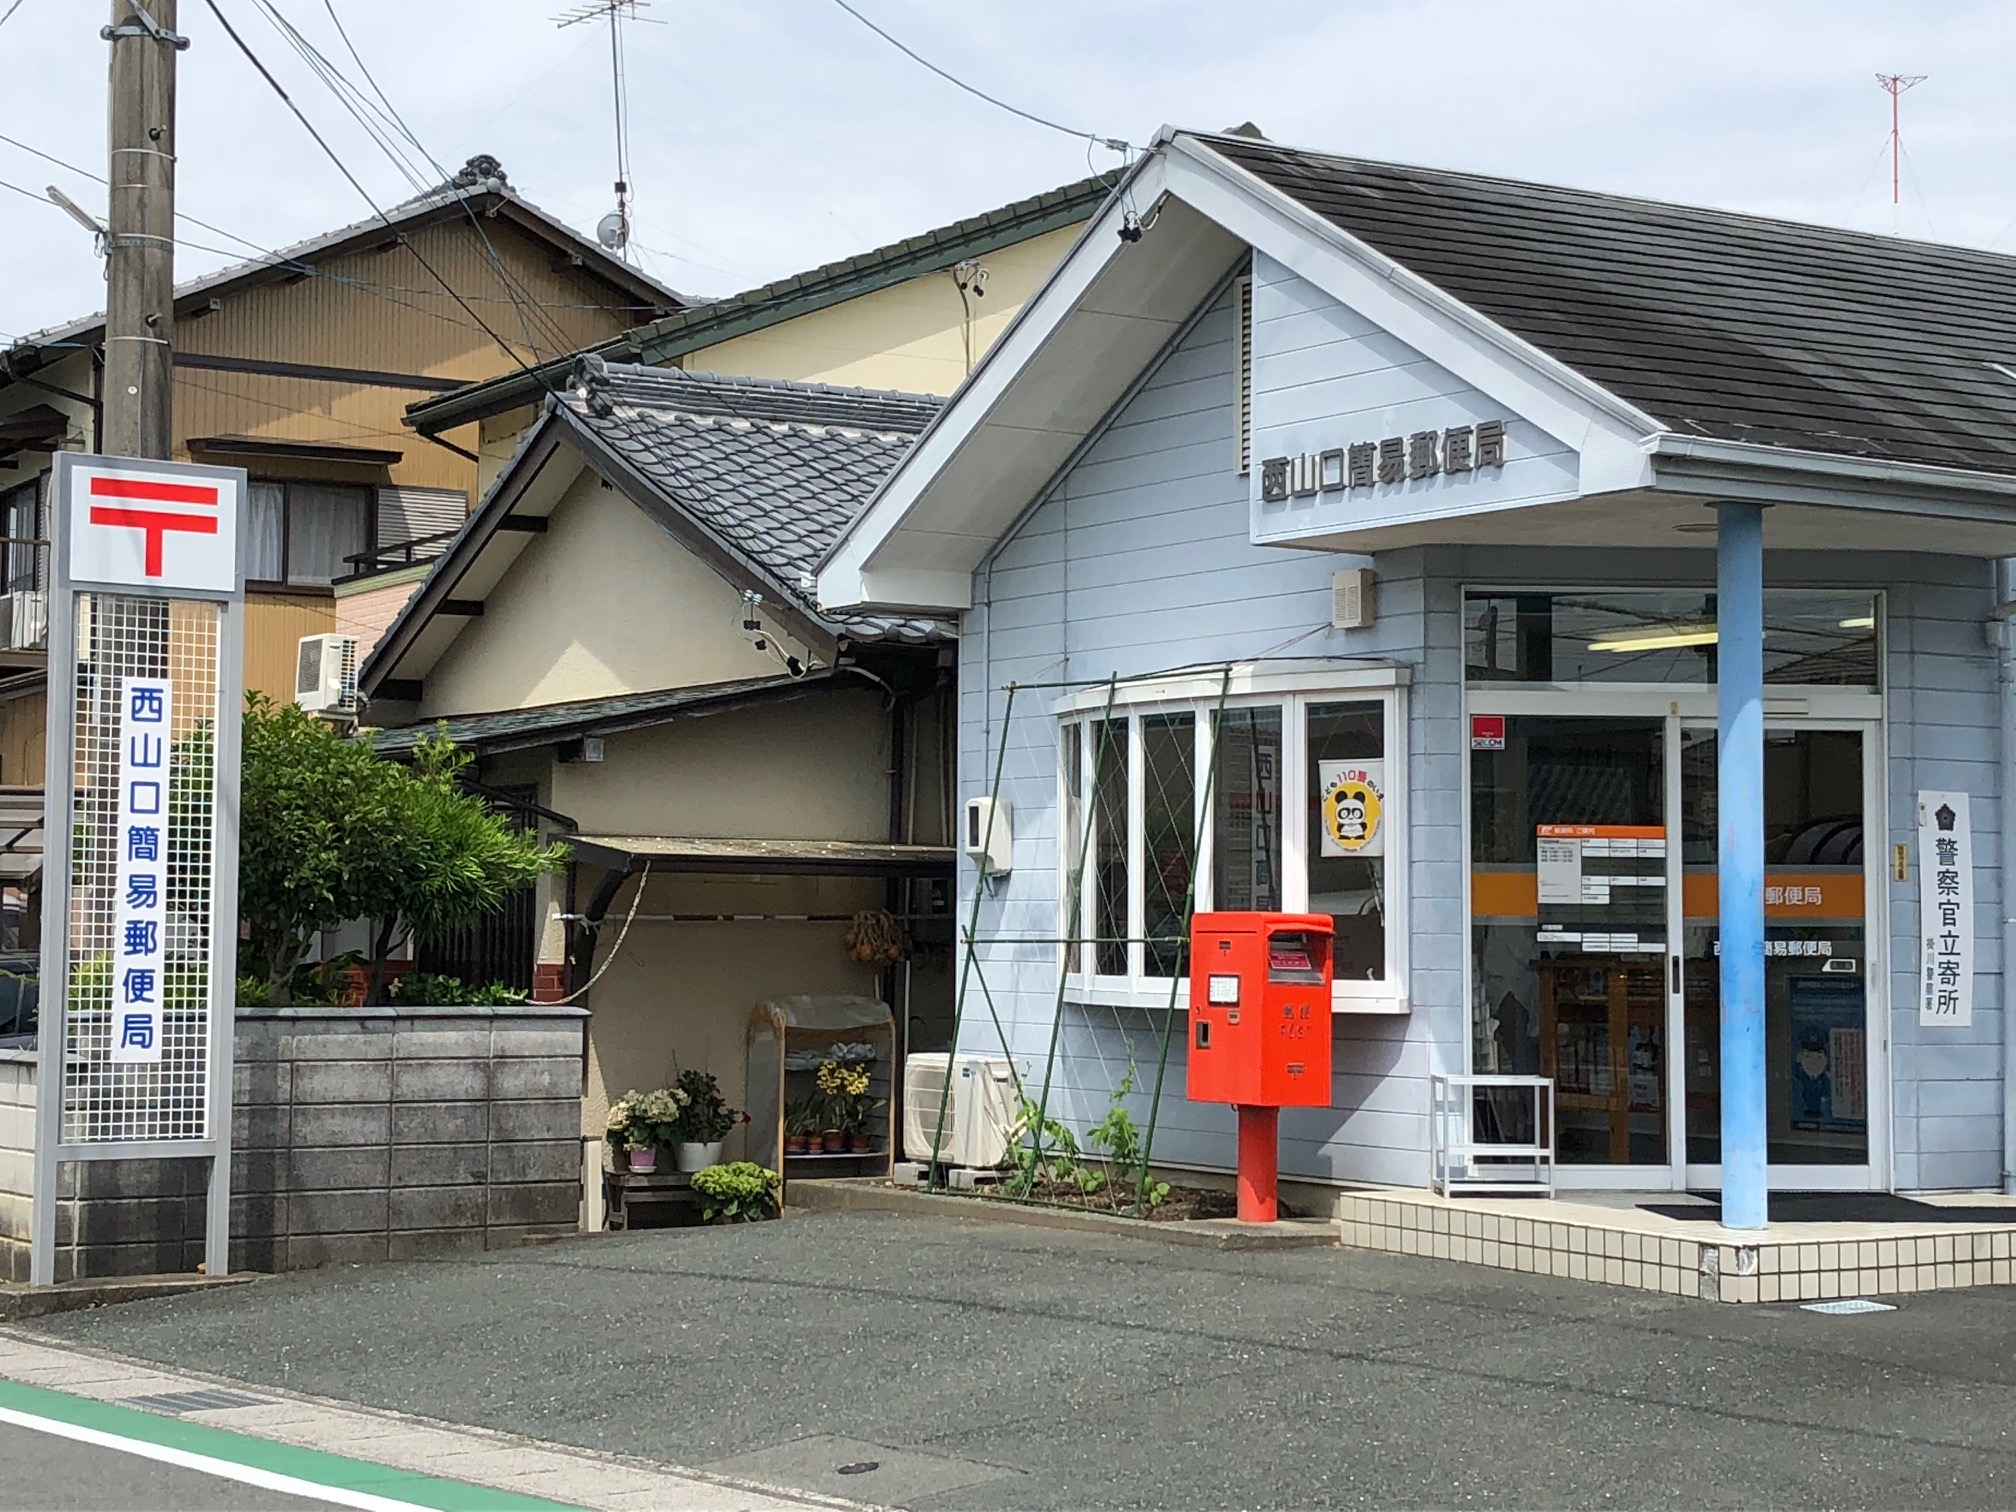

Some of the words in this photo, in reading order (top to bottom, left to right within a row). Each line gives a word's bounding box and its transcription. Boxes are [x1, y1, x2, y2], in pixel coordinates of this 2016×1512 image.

[1262, 419, 1505, 503] 西山口簡易郵便局
[120, 685, 164, 1050] 西山口簡易郵便局
[1765, 886, 1823, 906] 郵便局
[1935, 837, 1962, 1016] 警察官立寄所
